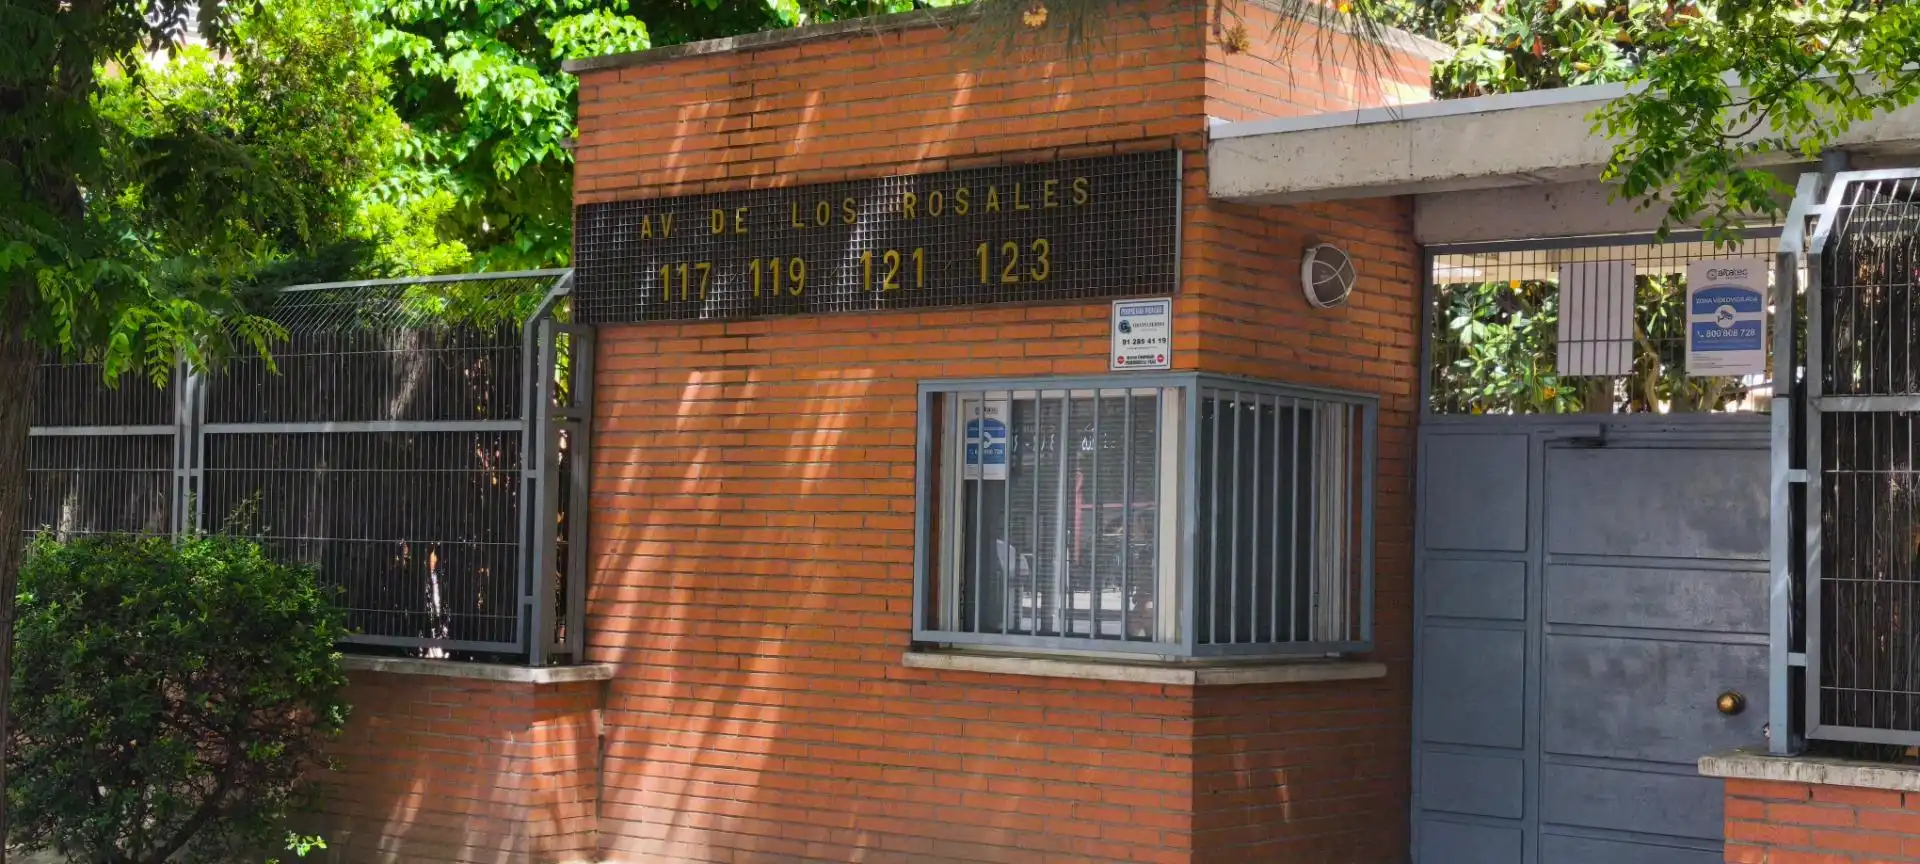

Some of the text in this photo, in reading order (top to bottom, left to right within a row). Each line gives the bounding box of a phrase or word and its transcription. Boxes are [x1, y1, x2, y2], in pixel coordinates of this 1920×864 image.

[641, 176, 1089, 240] AV DE LOS ROSALES
[659, 238, 1051, 301] 117 119 121 123
